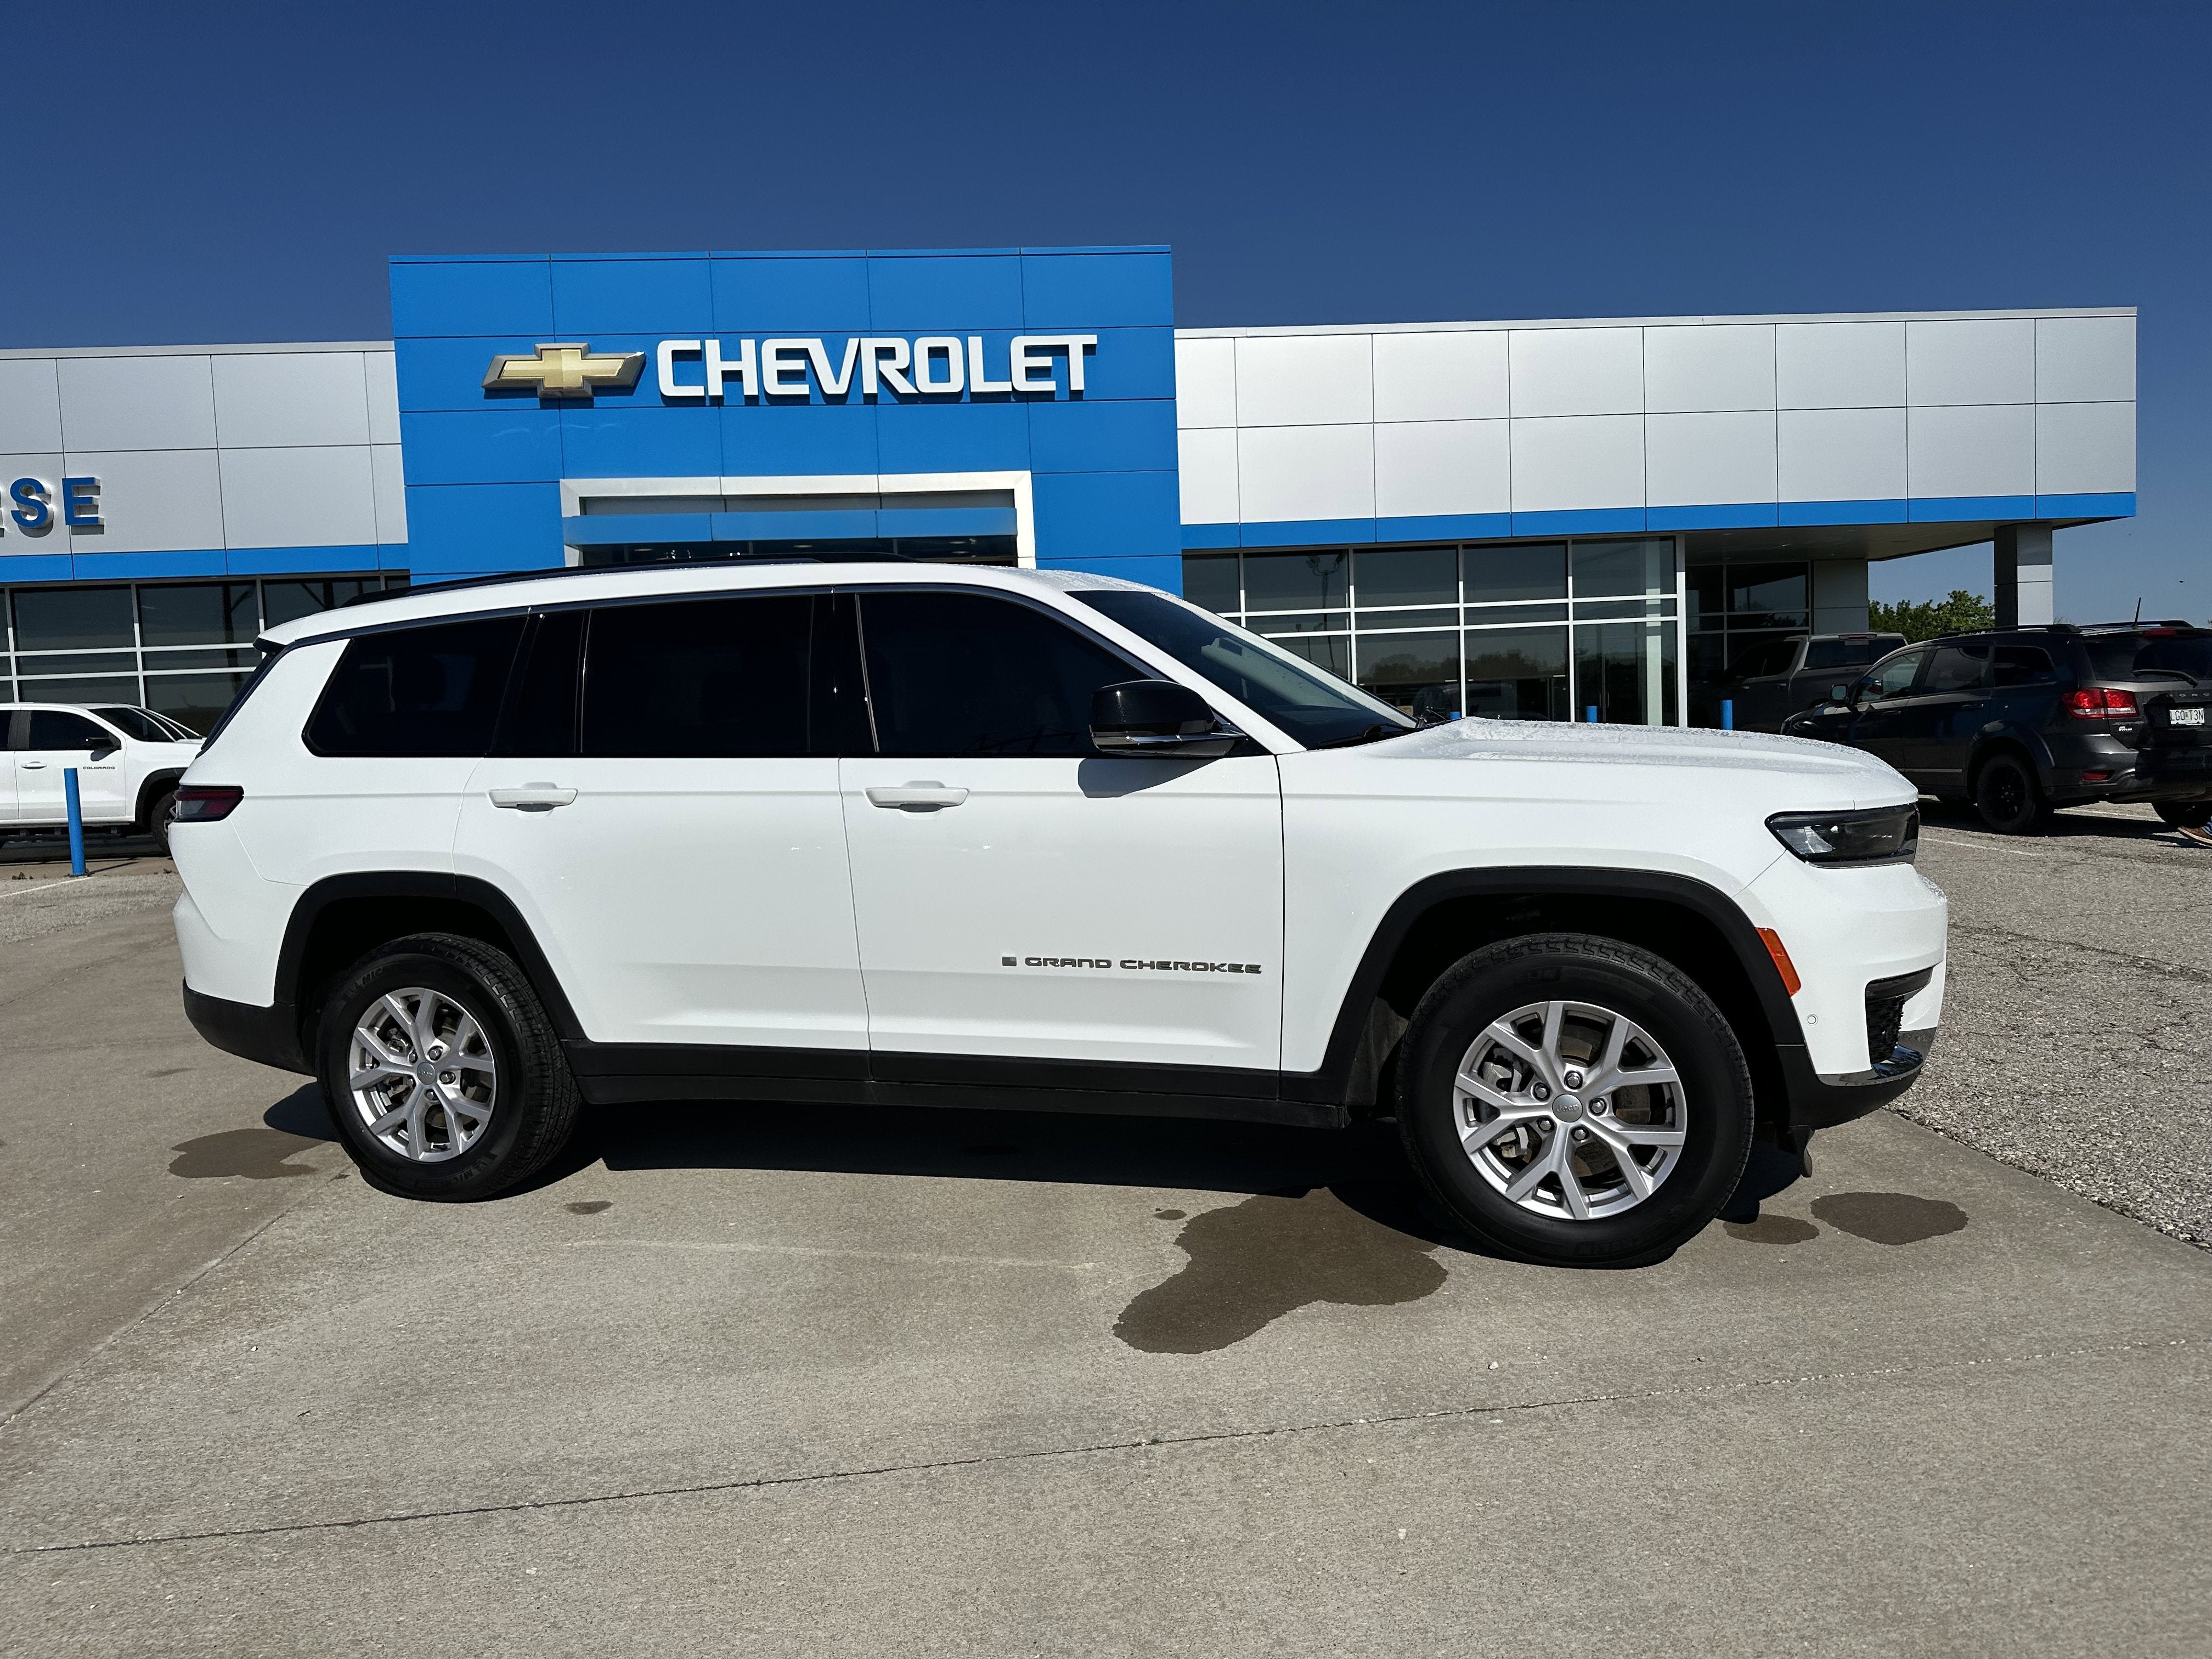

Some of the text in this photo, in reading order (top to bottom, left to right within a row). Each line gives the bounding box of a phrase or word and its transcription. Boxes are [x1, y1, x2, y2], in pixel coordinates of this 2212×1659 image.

[657, 335, 1097, 396] CHEVROLET
[0, 477, 102, 528] SE
[2188, 710, 2204, 720] T3N
[1025, 956, 1262, 974] GRAND CHEROKEE
[1556, 1104, 1579, 1113] Jeep
